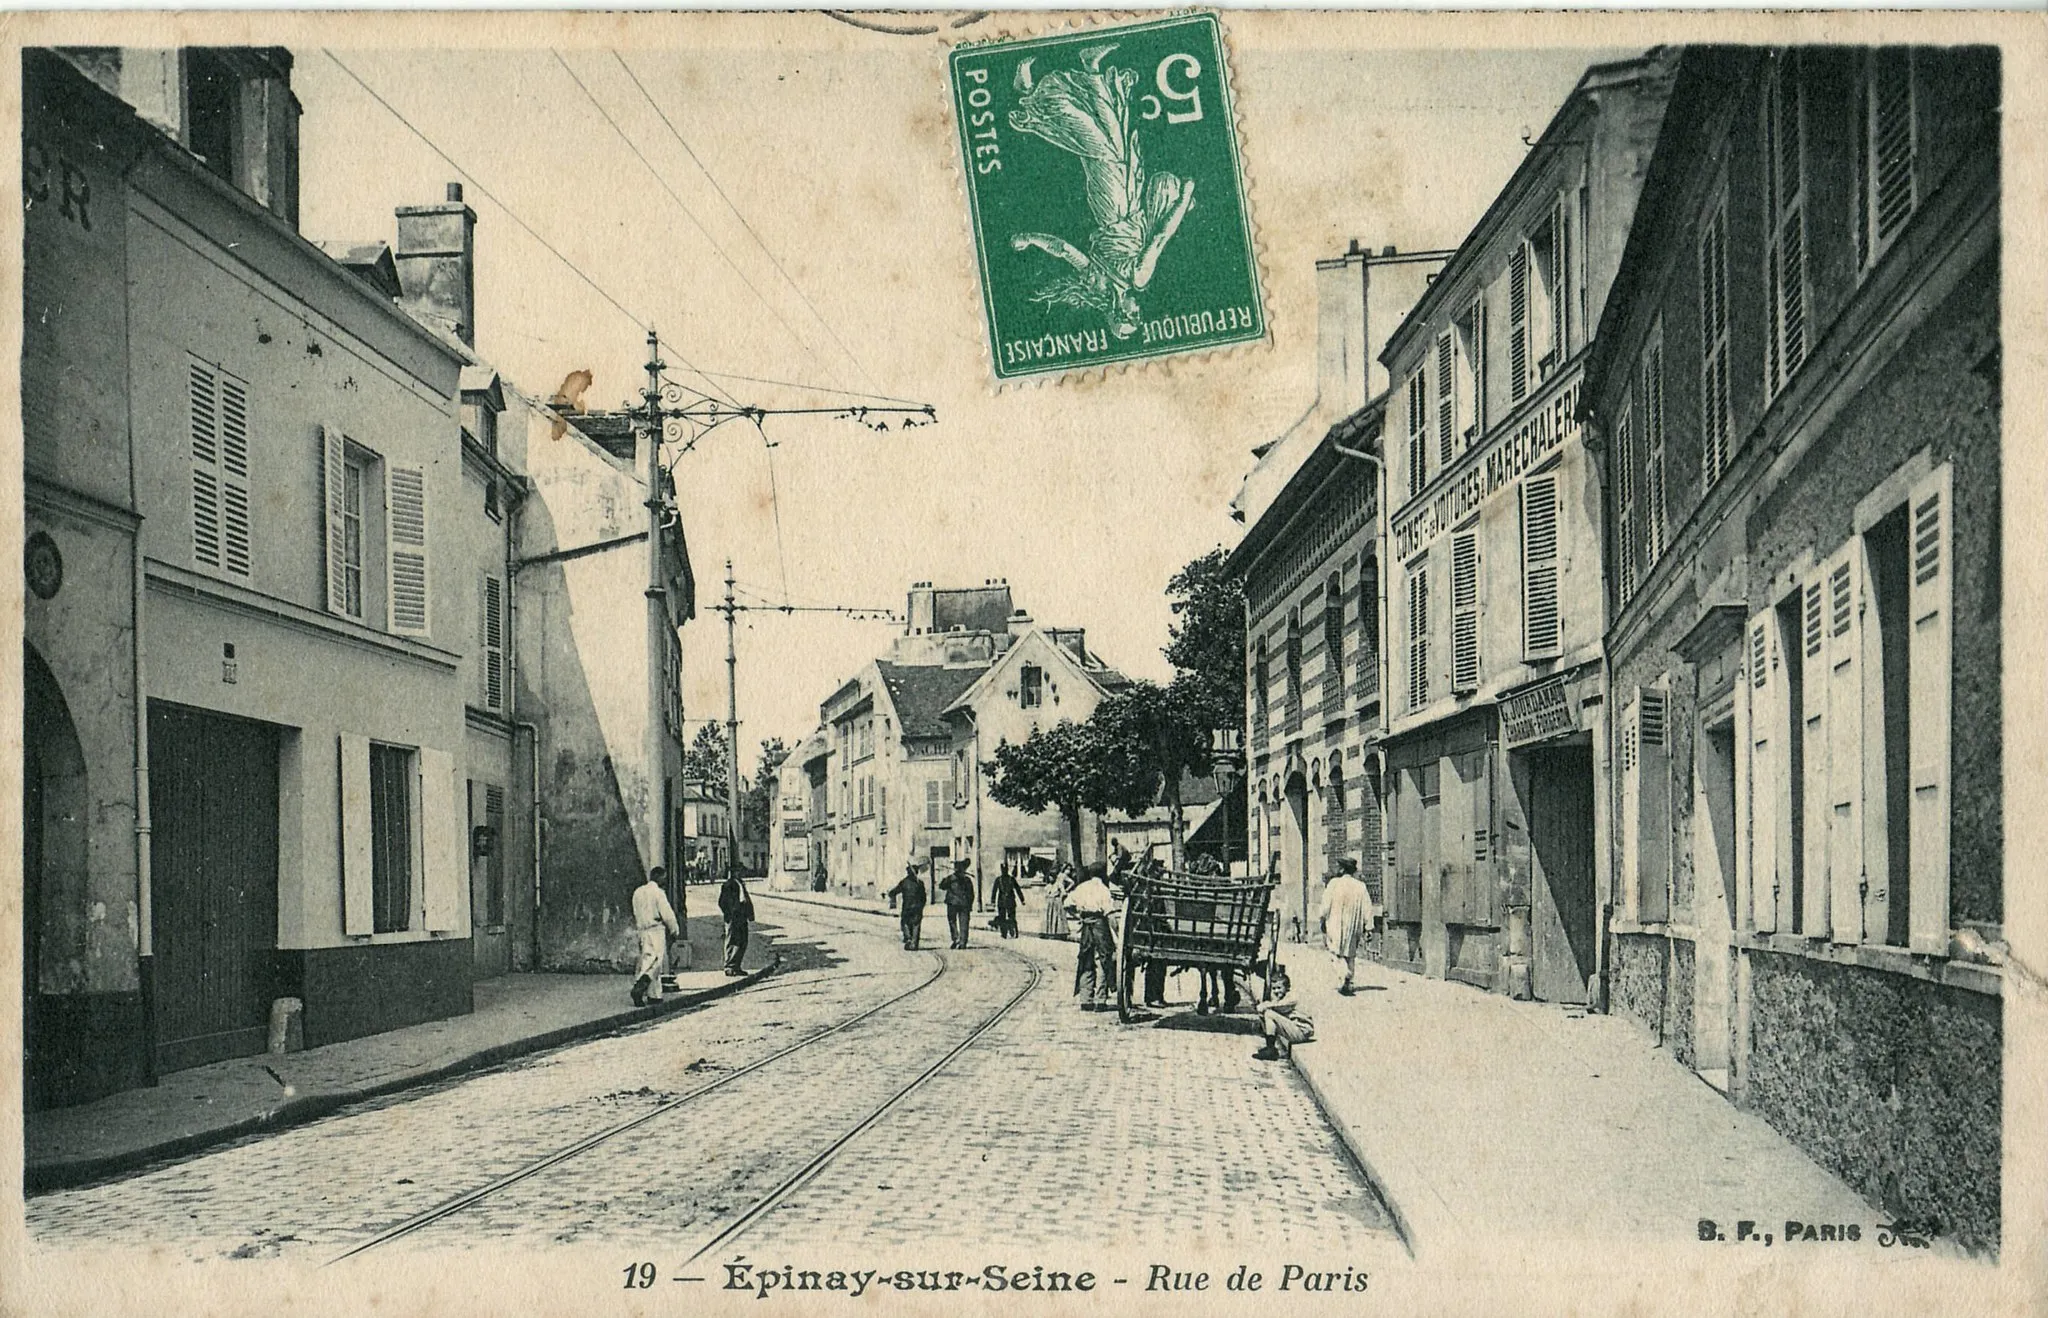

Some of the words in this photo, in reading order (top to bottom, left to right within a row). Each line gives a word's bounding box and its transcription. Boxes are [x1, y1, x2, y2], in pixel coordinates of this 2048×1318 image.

[965, 69, 1003, 176] POSTES
[1006, 328, 1109, 365] FRANÇAISE
[1434, 465, 1481, 535] VOITURES
